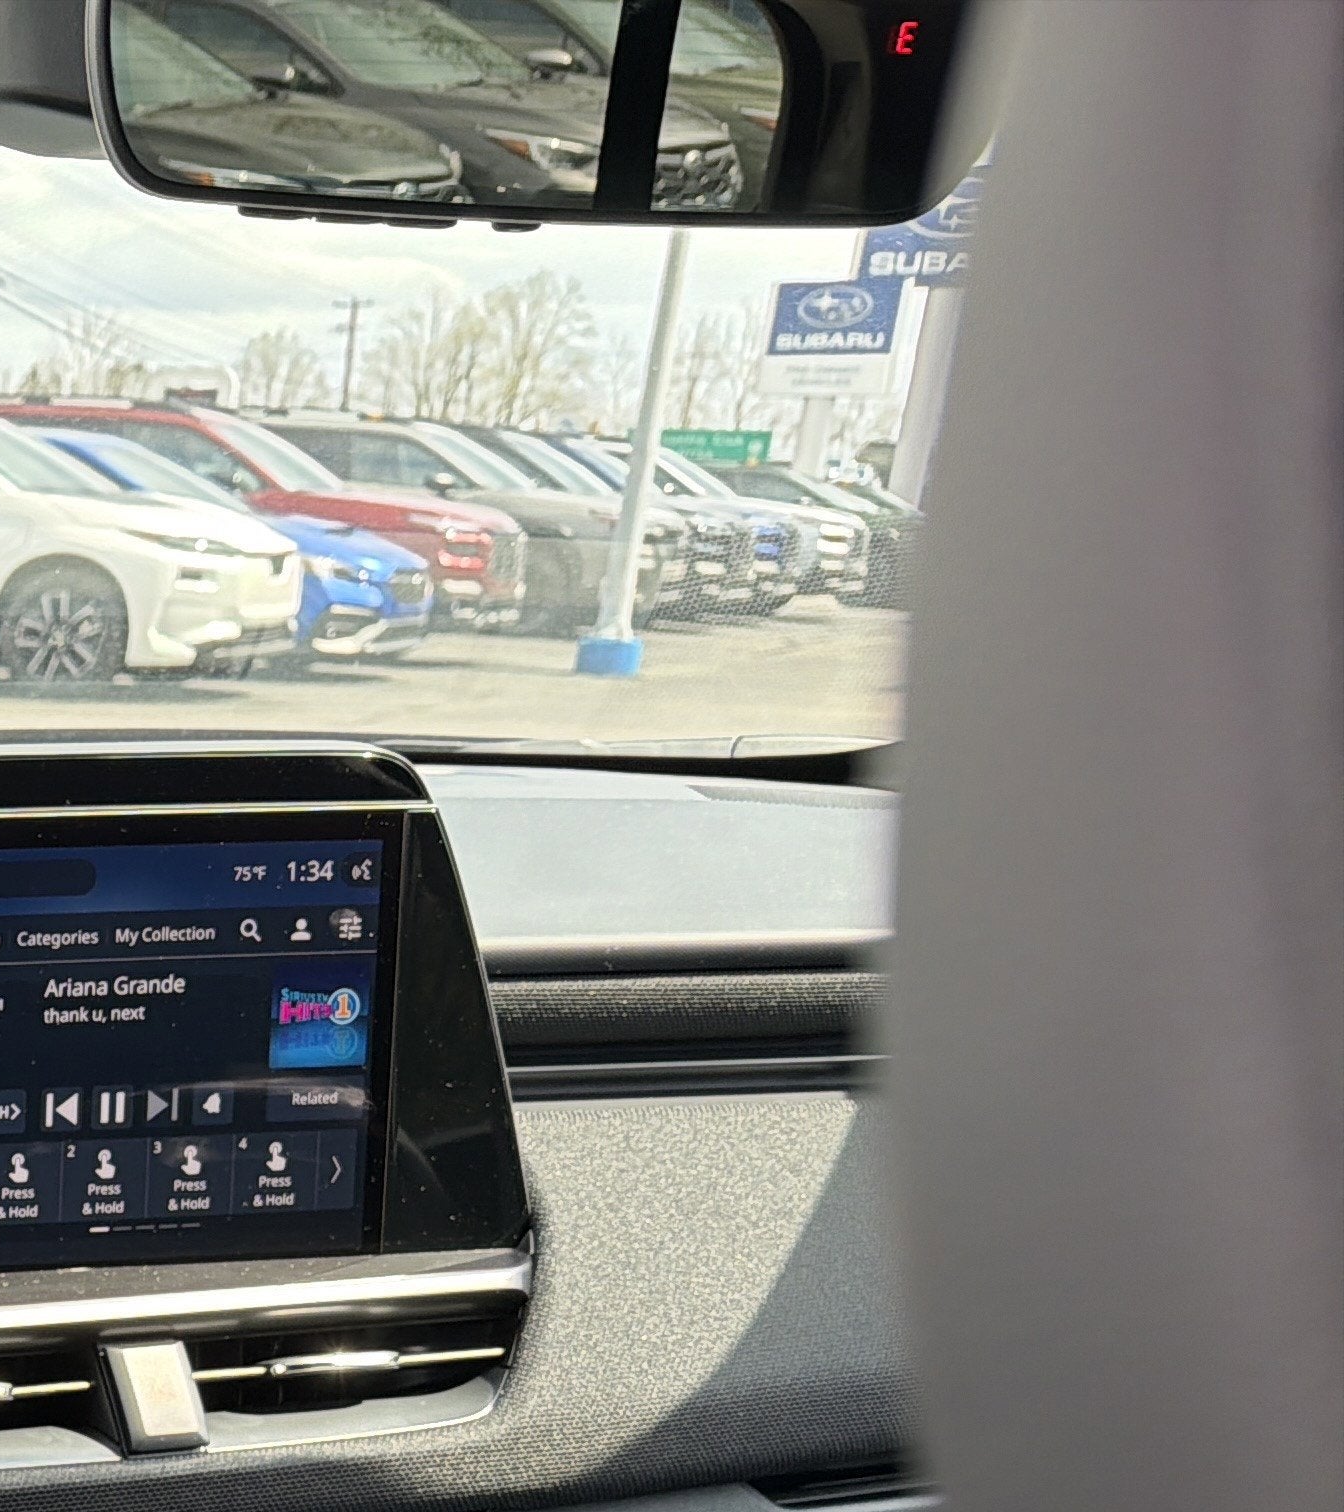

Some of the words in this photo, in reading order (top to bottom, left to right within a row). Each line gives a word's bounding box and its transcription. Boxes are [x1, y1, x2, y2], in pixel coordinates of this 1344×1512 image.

[895, 21, 919, 55] E
[869, 250, 969, 276] SUBA
[775, 332, 885, 351] SUBARU
[233, 864, 266, 882] 75°F
[287, 860, 334, 883] 1:34
[16, 929, 99, 950] Categories
[115, 928, 139, 948] My
[141, 925, 216, 943] Collection
[43, 976, 108, 998] Ariana
[113, 973, 186, 996] Grande
[334, 993, 352, 1018] 1
[43, 1006, 90, 1025] thank
[91, 1009, 107, 1025] u,
[110, 1005, 146, 1021] next
[291, 1091, 339, 1106] Related
[153, 1141, 162, 1154] 3
[238, 1137, 249, 1150] 4
[67, 1146, 76, 1158] 2
[87, 1182, 122, 1196] Press
[173, 1179, 207, 1193] Press
[258, 1175, 292, 1189] Press
[1, 1187, 35, 1201] Press
[253, 1194, 264, 1208] &
[265, 1192, 296, 1207] Hold
[8, 1204, 39, 1219] Hold
[81, 1202, 93, 1216] &
[95, 1201, 125, 1215] Hold
[167, 1198, 179, 1212] &
[180, 1197, 210, 1211] Hold
